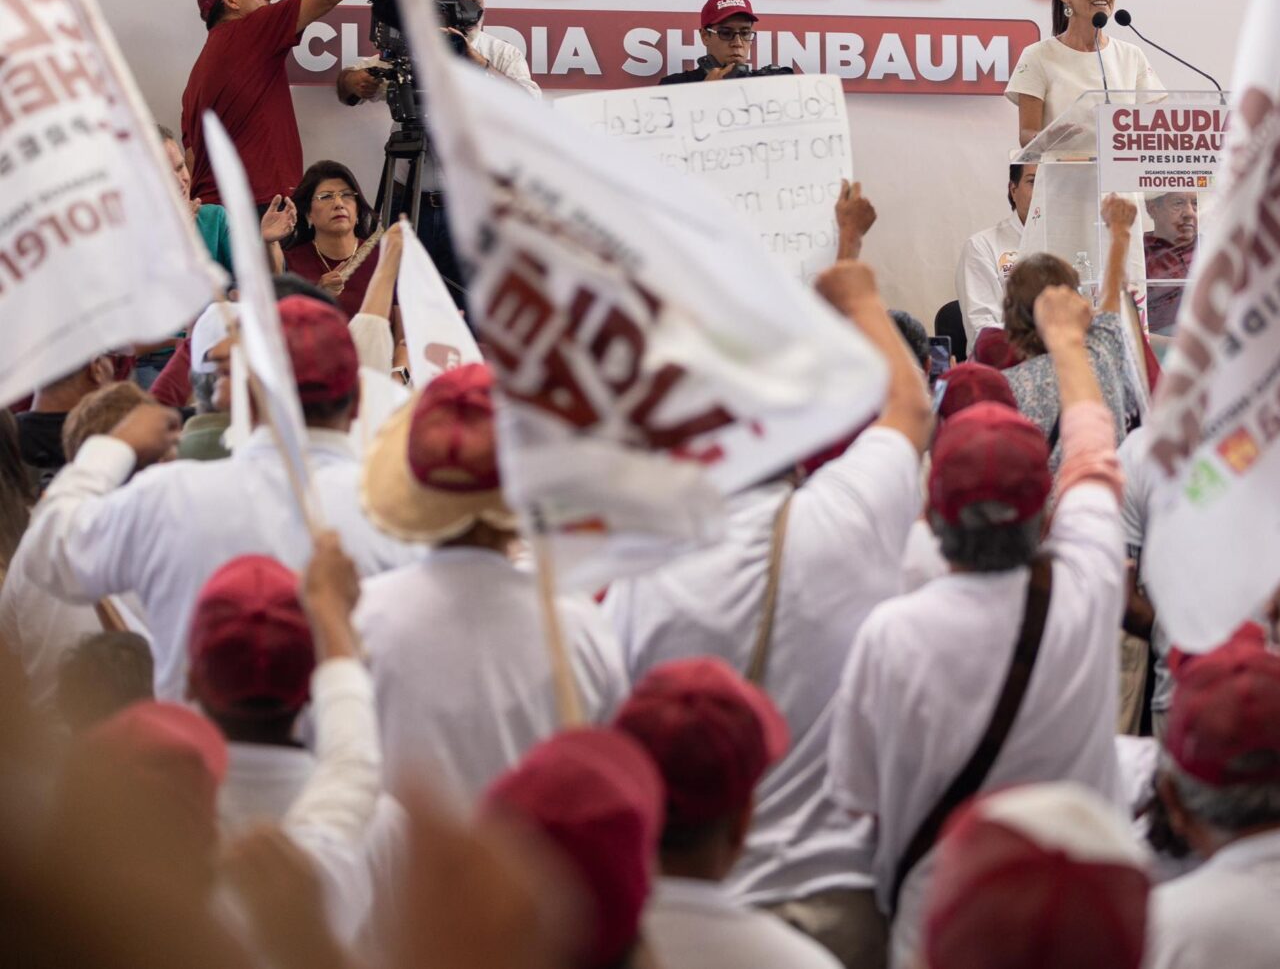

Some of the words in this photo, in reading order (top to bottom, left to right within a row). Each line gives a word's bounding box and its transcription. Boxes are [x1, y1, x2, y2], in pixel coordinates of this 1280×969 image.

[620, 26, 1010, 83] SHINBAUM
[1112, 133, 1225, 151] SHEINBAU
[1140, 155, 1217, 164] PRESIDENTA
[1138, 176, 1196, 188] morena
